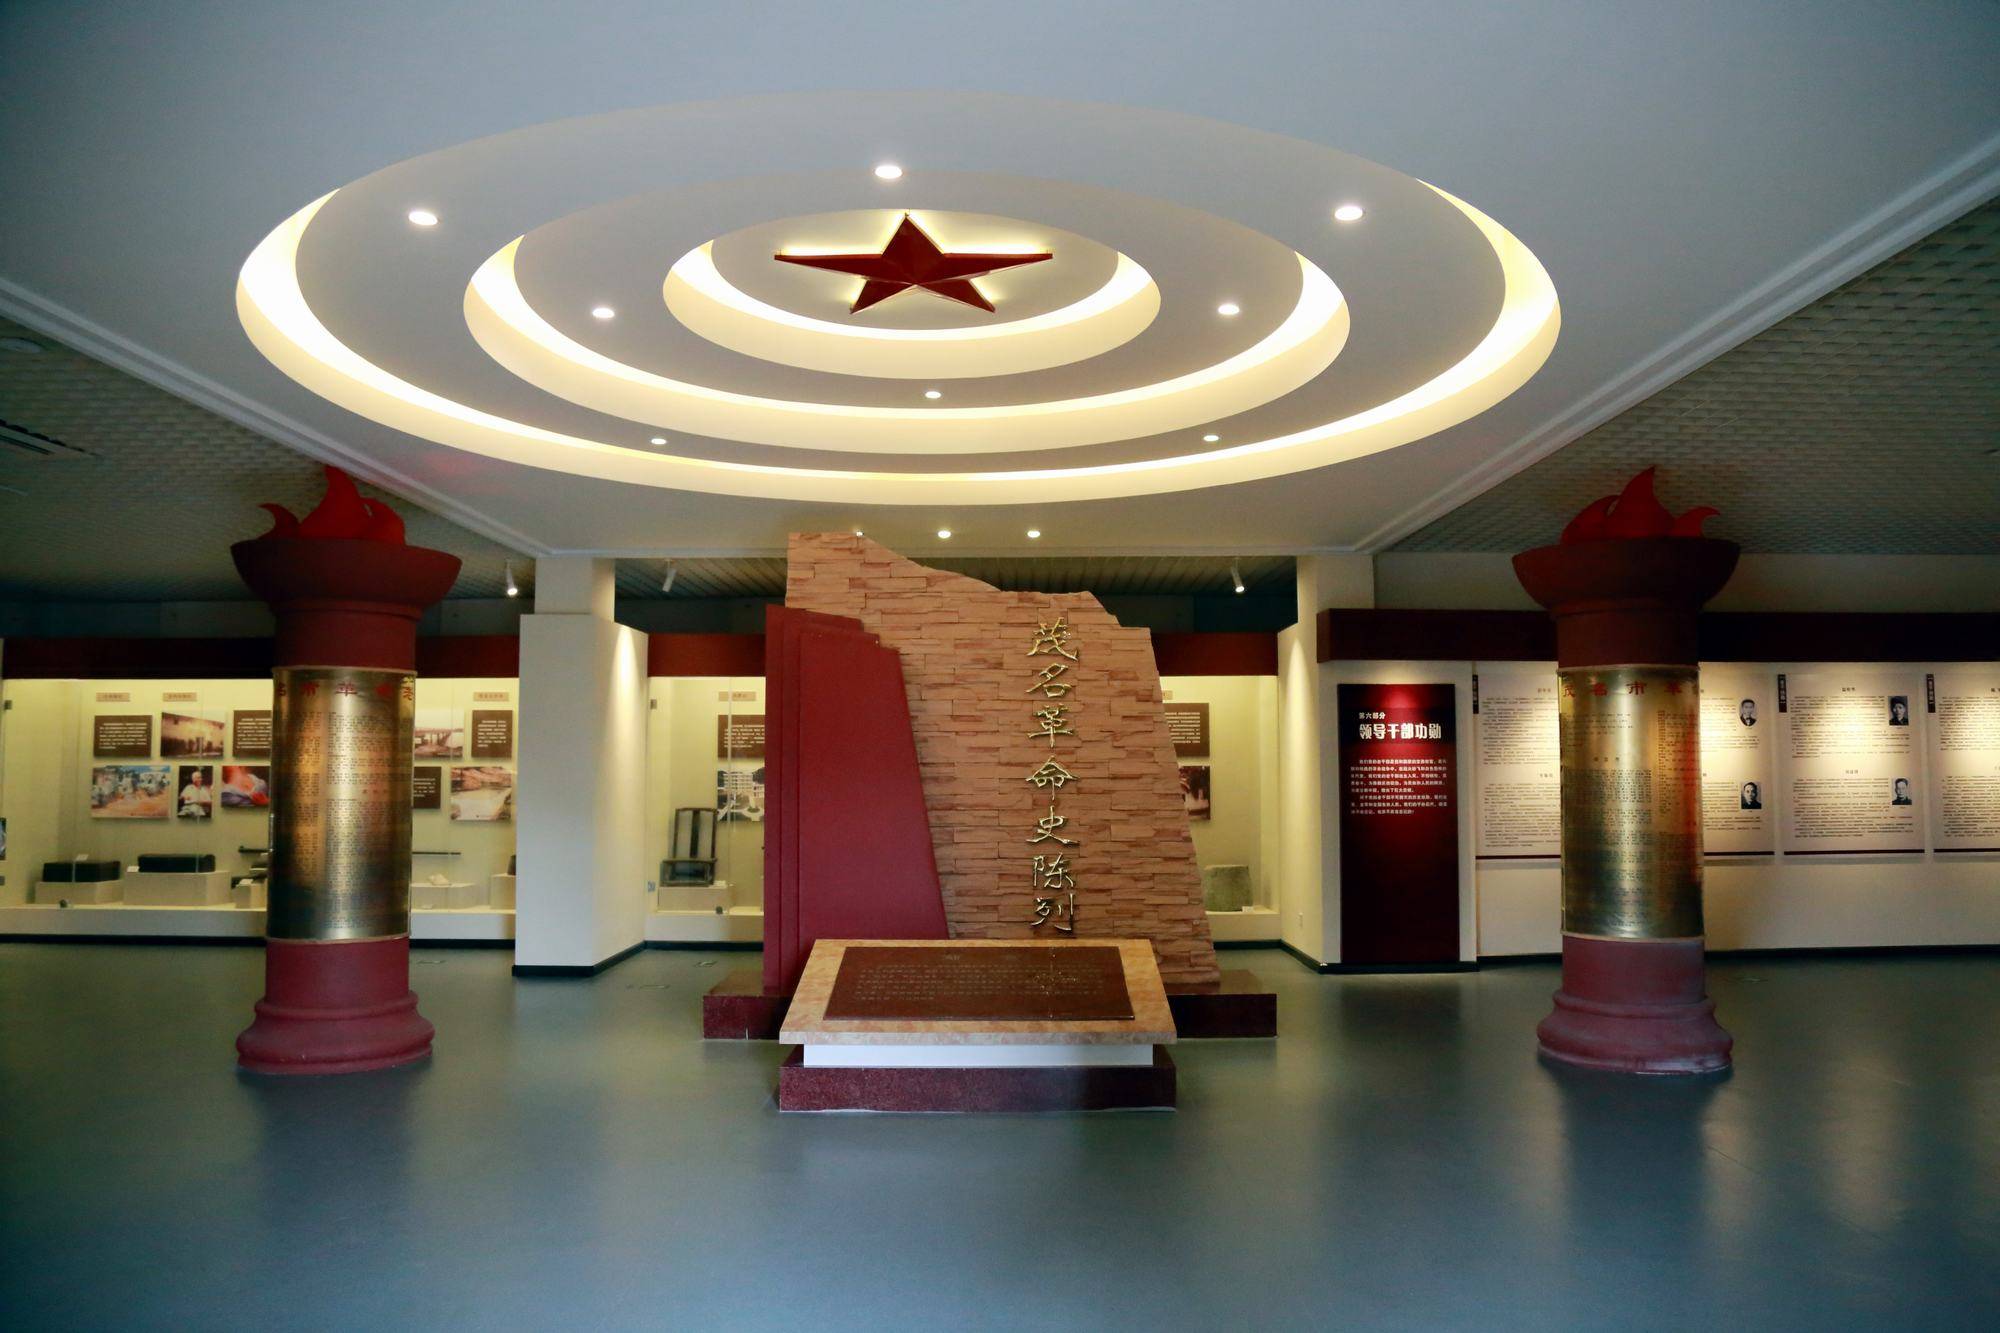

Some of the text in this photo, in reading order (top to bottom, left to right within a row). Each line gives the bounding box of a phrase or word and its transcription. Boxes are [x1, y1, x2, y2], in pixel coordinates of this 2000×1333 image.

[1025, 616, 1079, 931] 茂名革命史陈列
[1359, 722, 1442, 740] 领导干部功勋
